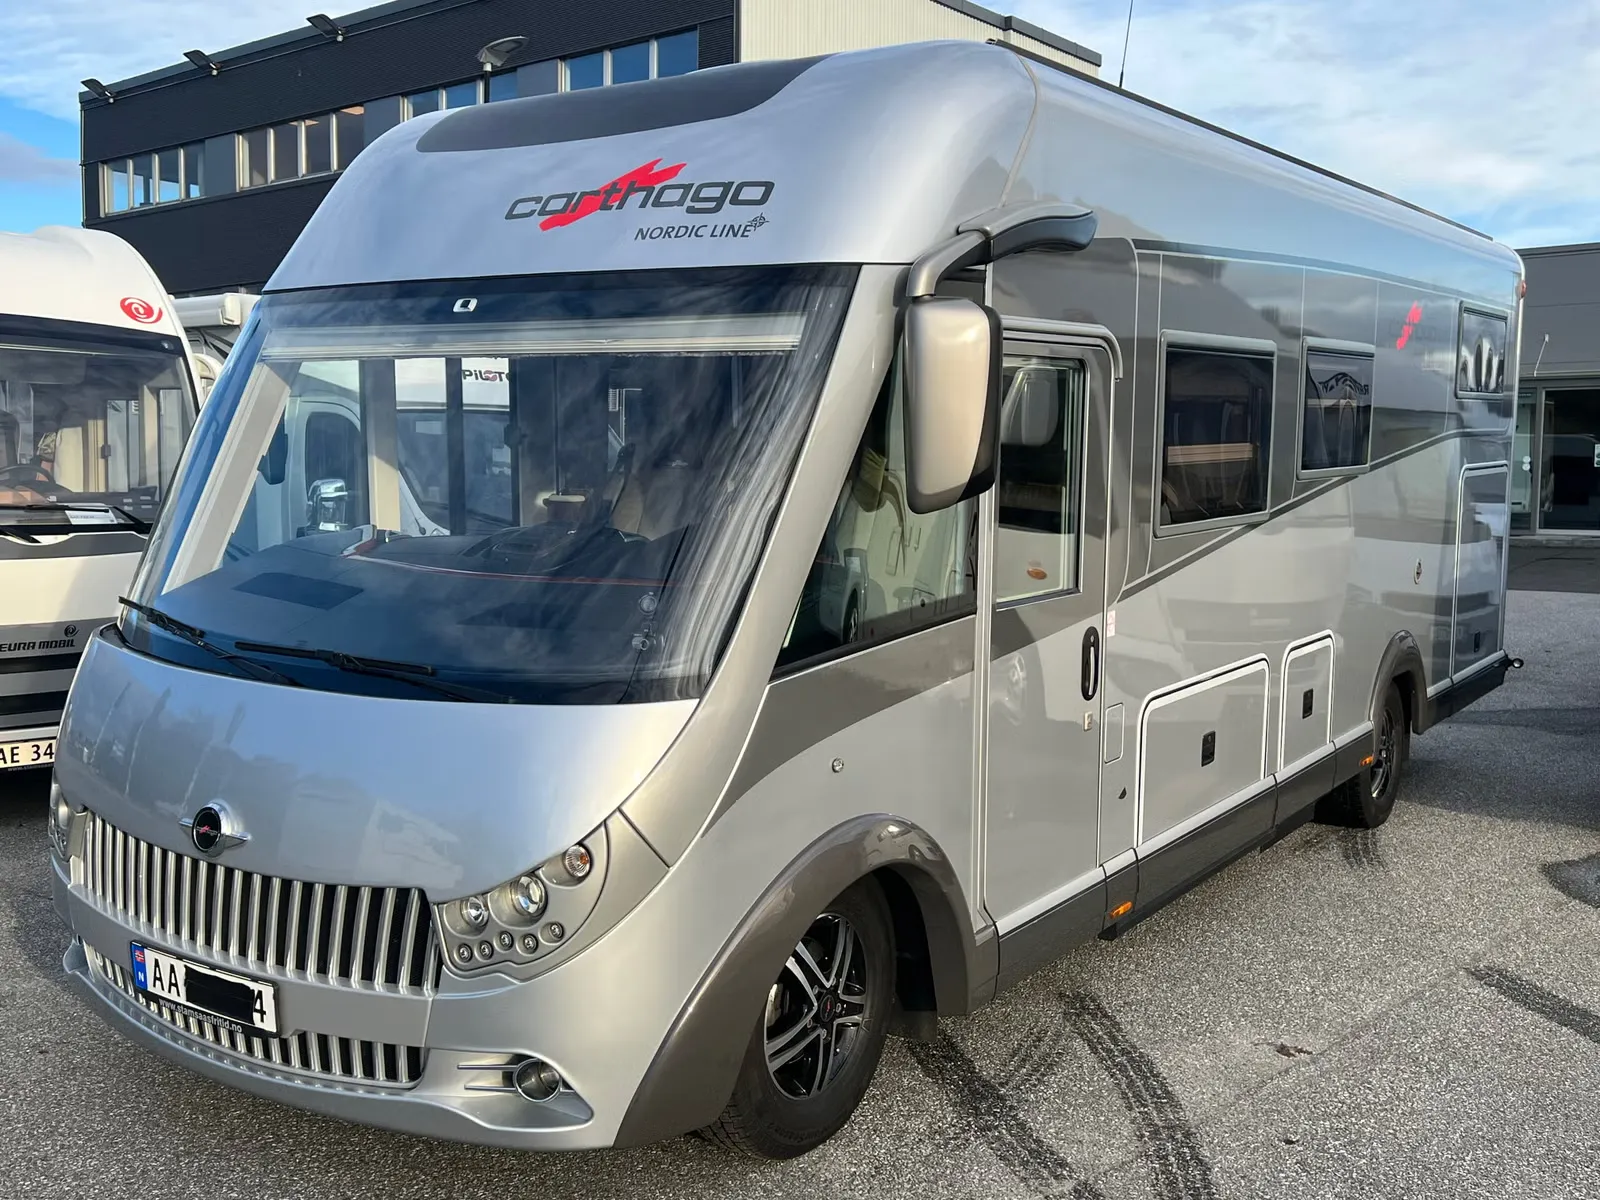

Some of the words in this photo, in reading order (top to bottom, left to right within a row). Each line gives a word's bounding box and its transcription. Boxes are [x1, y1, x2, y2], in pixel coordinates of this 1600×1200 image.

[505, 180, 775, 220] carthago
[634, 225, 708, 240] NORDIC
[709, 223, 753, 238] LINE
[0, 643, 36, 652] EURA
[38, 638, 76, 650] MOBIL
[153, 958, 181, 997] AA
